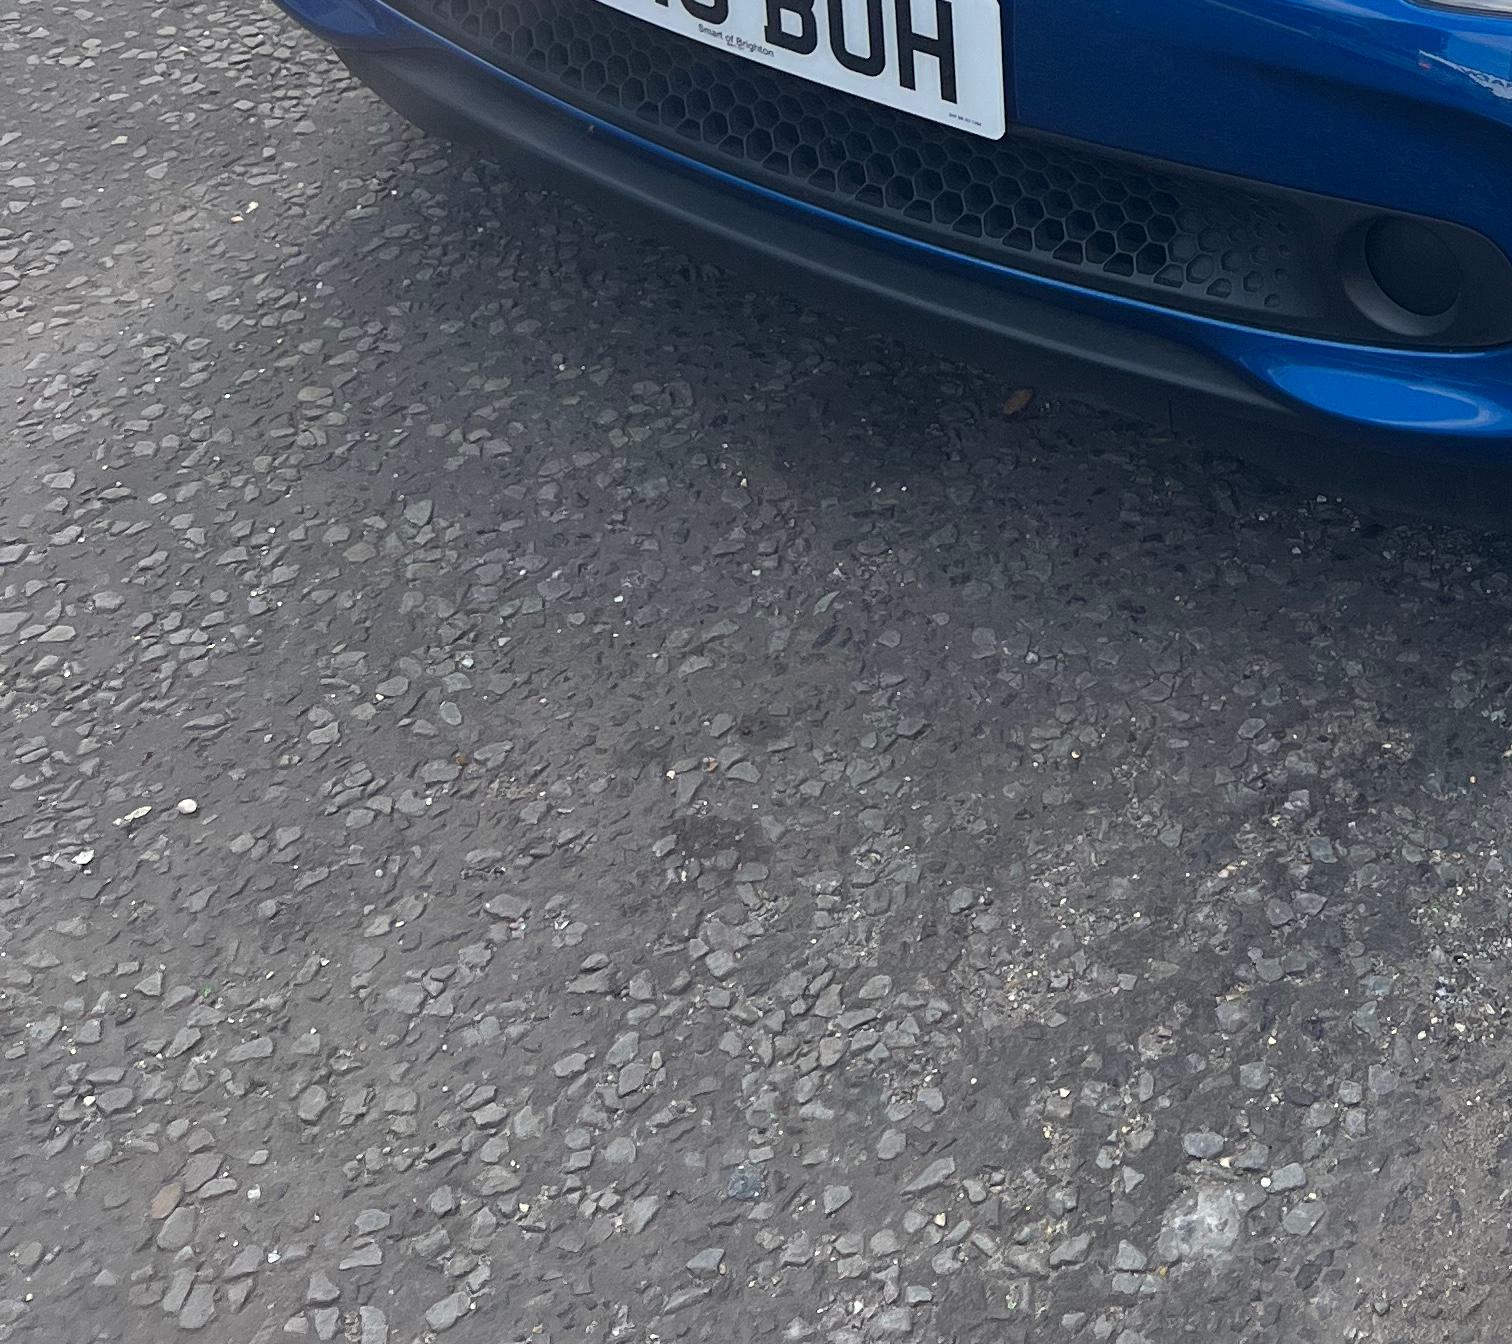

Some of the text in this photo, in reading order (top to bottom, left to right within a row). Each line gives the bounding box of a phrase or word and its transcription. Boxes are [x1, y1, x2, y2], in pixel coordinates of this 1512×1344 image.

[698, 23, 723, 41] Smart
[725, 34, 734, 43] of
[735, 36, 775, 57] Brighton
